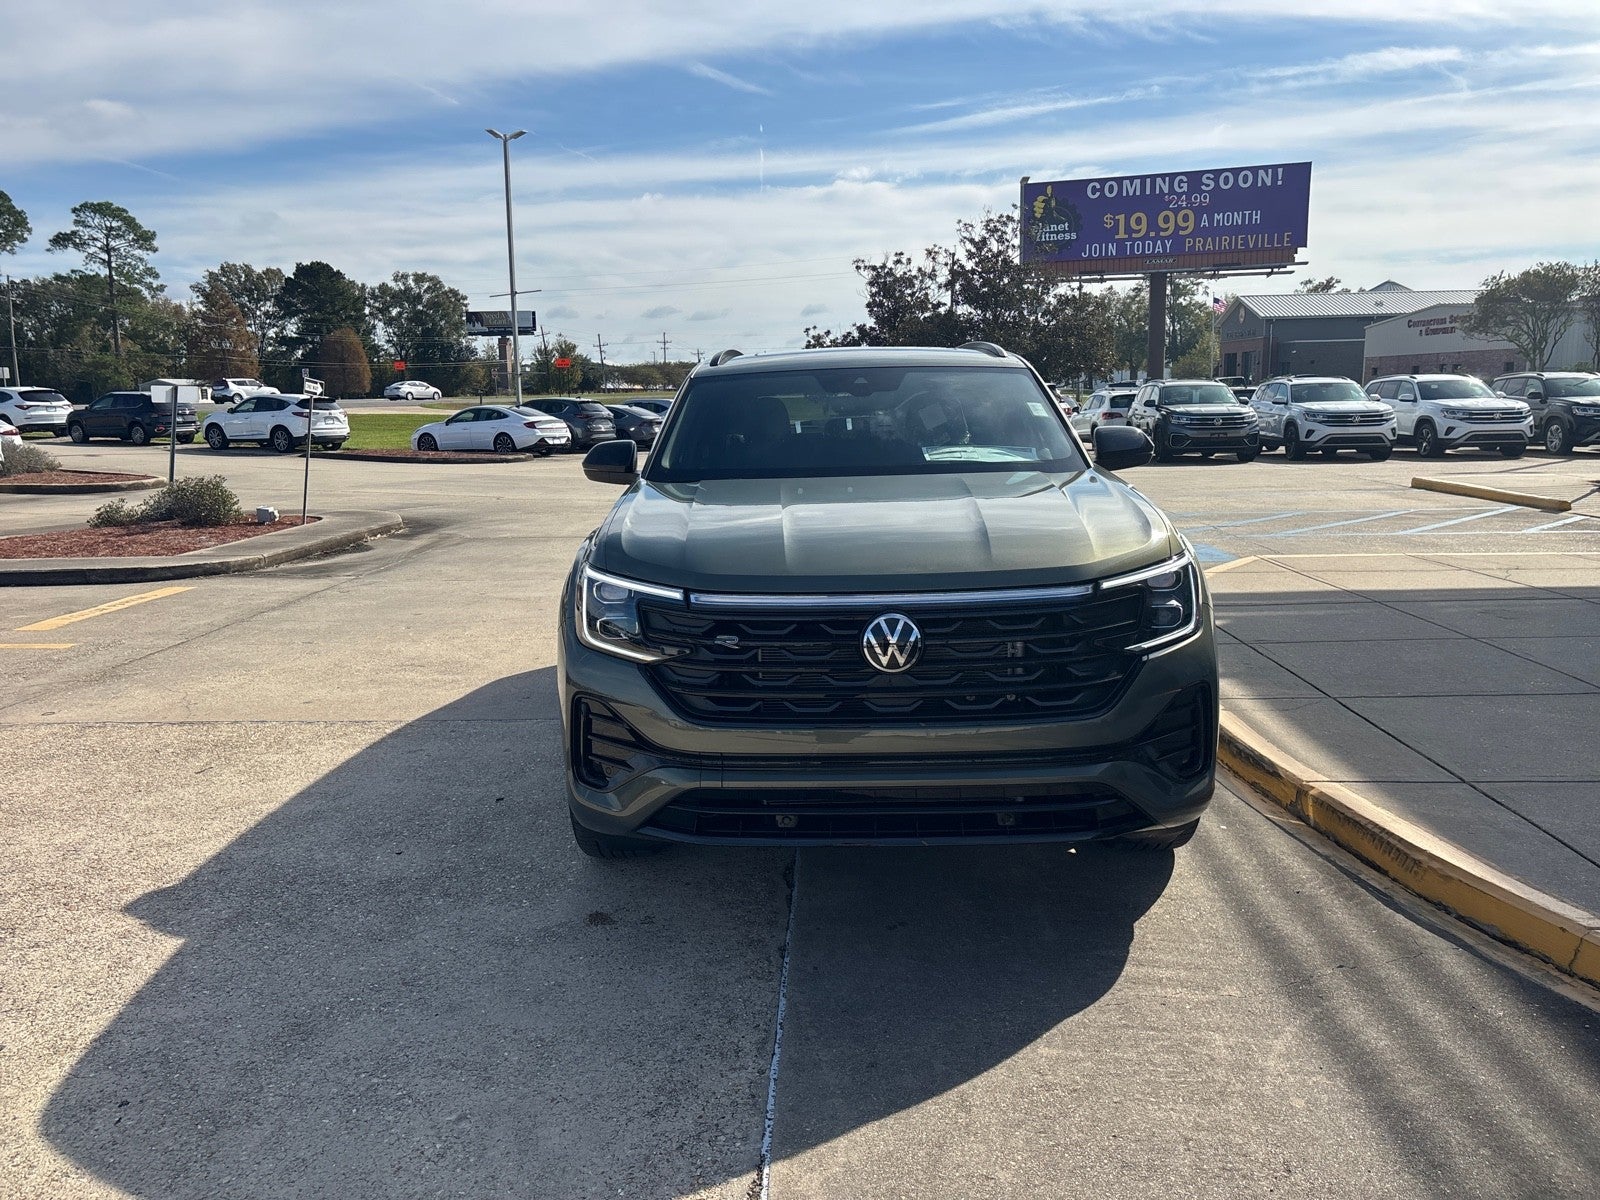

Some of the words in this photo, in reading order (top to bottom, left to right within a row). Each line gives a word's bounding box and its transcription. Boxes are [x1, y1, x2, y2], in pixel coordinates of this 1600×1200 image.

[1086, 175, 1188, 199] COMING
[1200, 167, 1284, 191] SOON!
[1164, 192, 1210, 208] $24.99
[1031, 222, 1069, 233] lanet
[1103, 209, 1195, 239] $19.99
[1200, 214, 1209, 228] A
[1214, 210, 1261, 227] MONTH
[1081, 243, 1117, 258] JOIN
[1124, 239, 1173, 255] TODAY
[1185, 232, 1293, 252] PRAIRIEVILLE
[864, 614, 921, 671] VW
